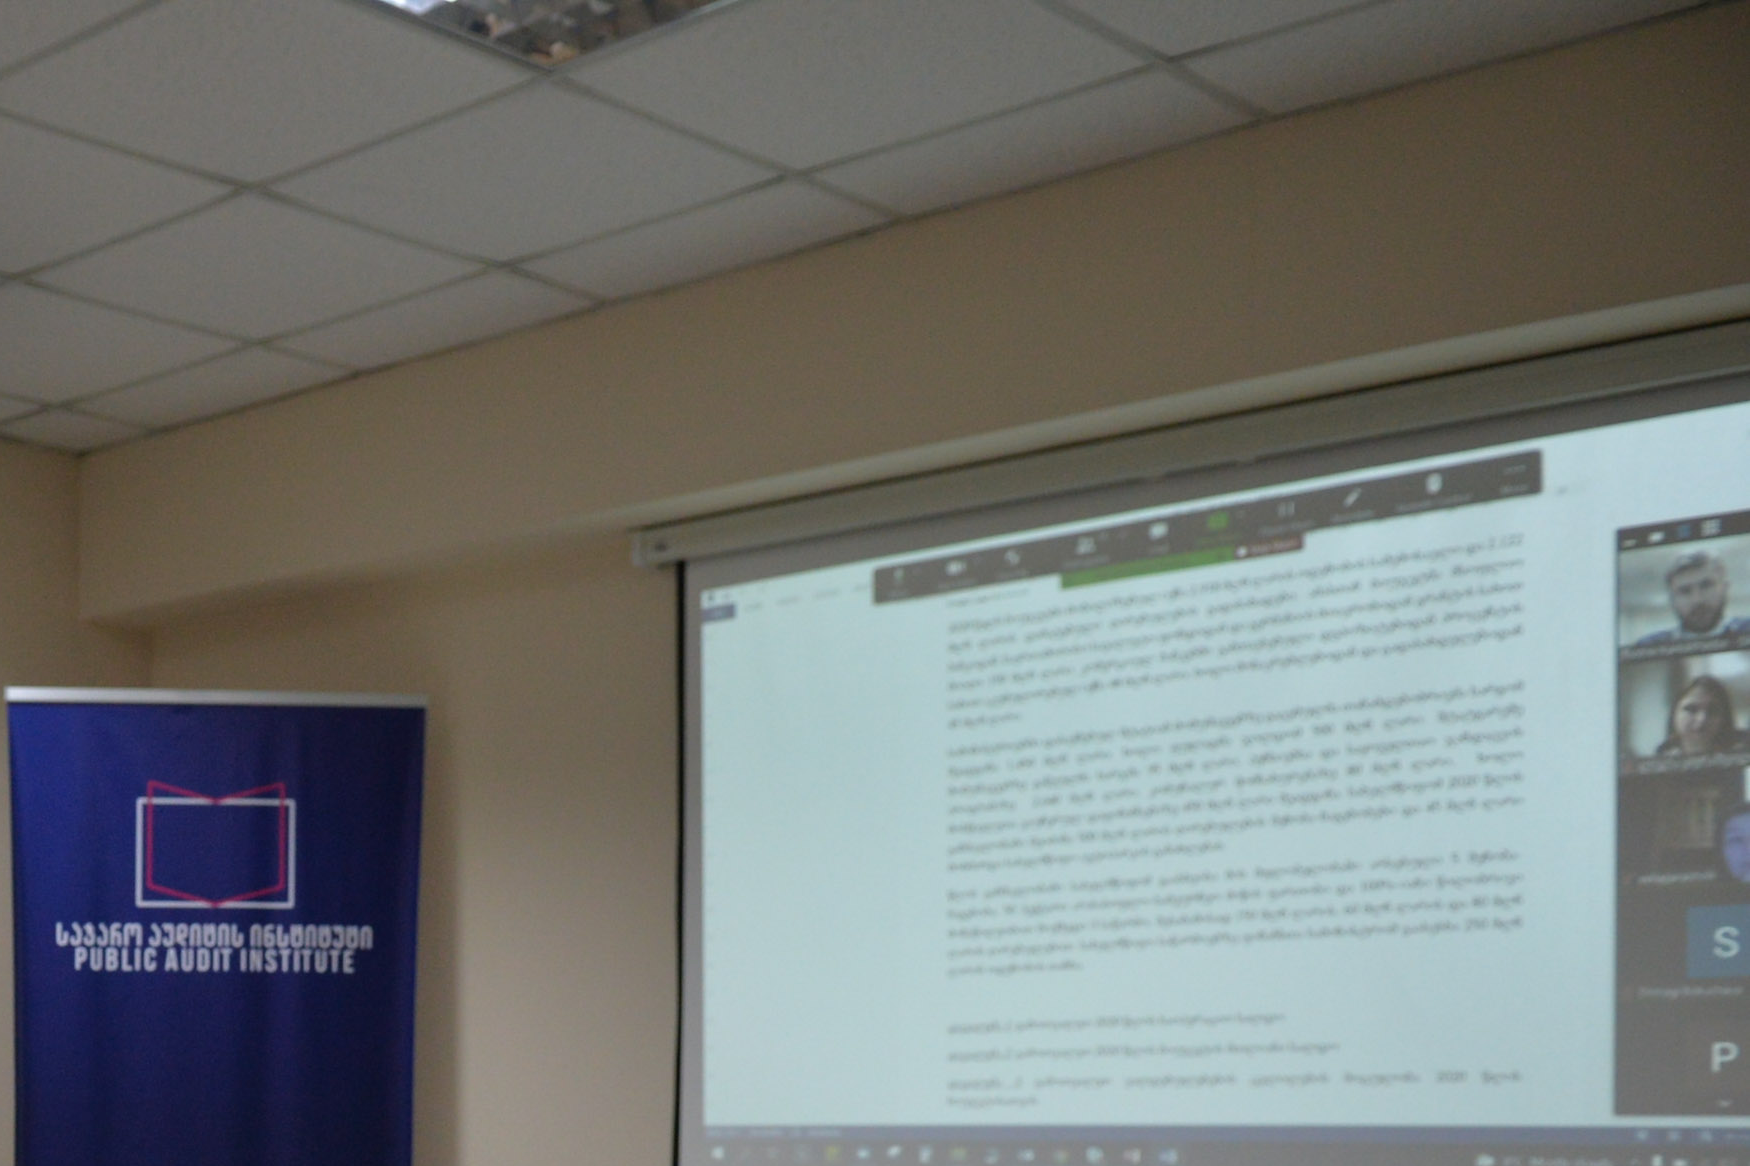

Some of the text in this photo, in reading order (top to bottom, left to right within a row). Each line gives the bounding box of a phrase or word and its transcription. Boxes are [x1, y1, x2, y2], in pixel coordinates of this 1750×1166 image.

[1713, 926, 1740, 959] S
[73, 947, 356, 974] PUBLIC AUDIT INSTITUTE
[1711, 1042, 1740, 1073] P
